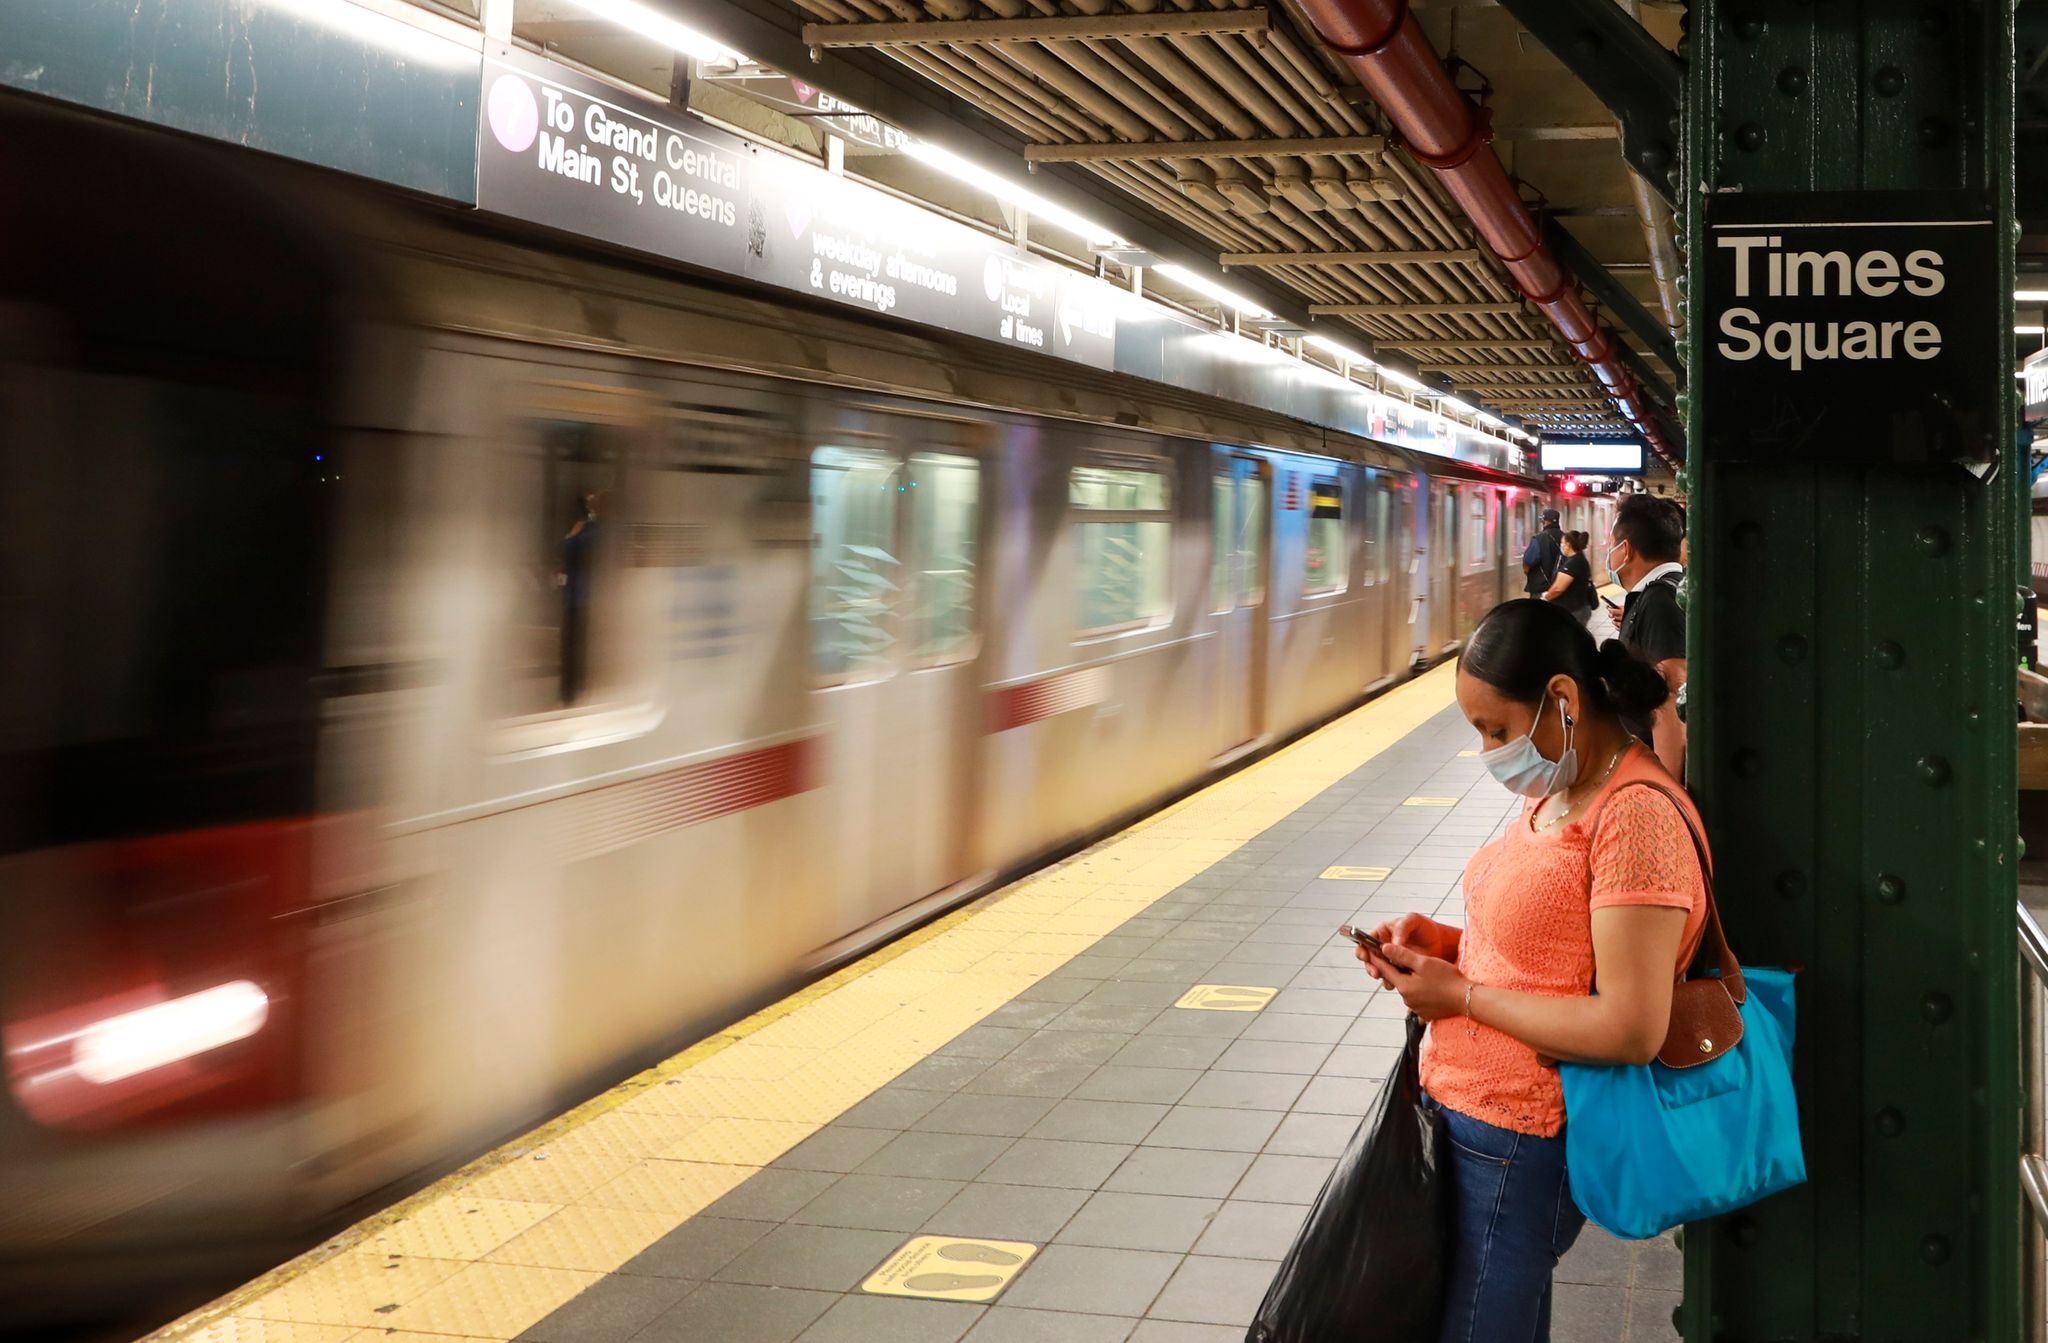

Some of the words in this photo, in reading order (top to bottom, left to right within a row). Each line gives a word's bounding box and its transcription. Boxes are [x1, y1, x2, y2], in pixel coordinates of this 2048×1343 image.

[541, 86, 575, 133] To
[584, 104, 658, 162] Grand
[665, 134, 740, 190] Central
[538, 130, 602, 186] Main
[611, 156, 643, 205] St,
[653, 170, 736, 227] Queens
[810, 258, 824, 289] &
[830, 270, 896, 311] evenings
[812, 231, 882, 278] weekday
[886, 250, 957, 296] afternoons
[1717, 235, 1946, 297] Times
[1001, 286, 1030, 317] Local
[1016, 318, 1043, 346] times
[1717, 307, 1943, 371] Square
